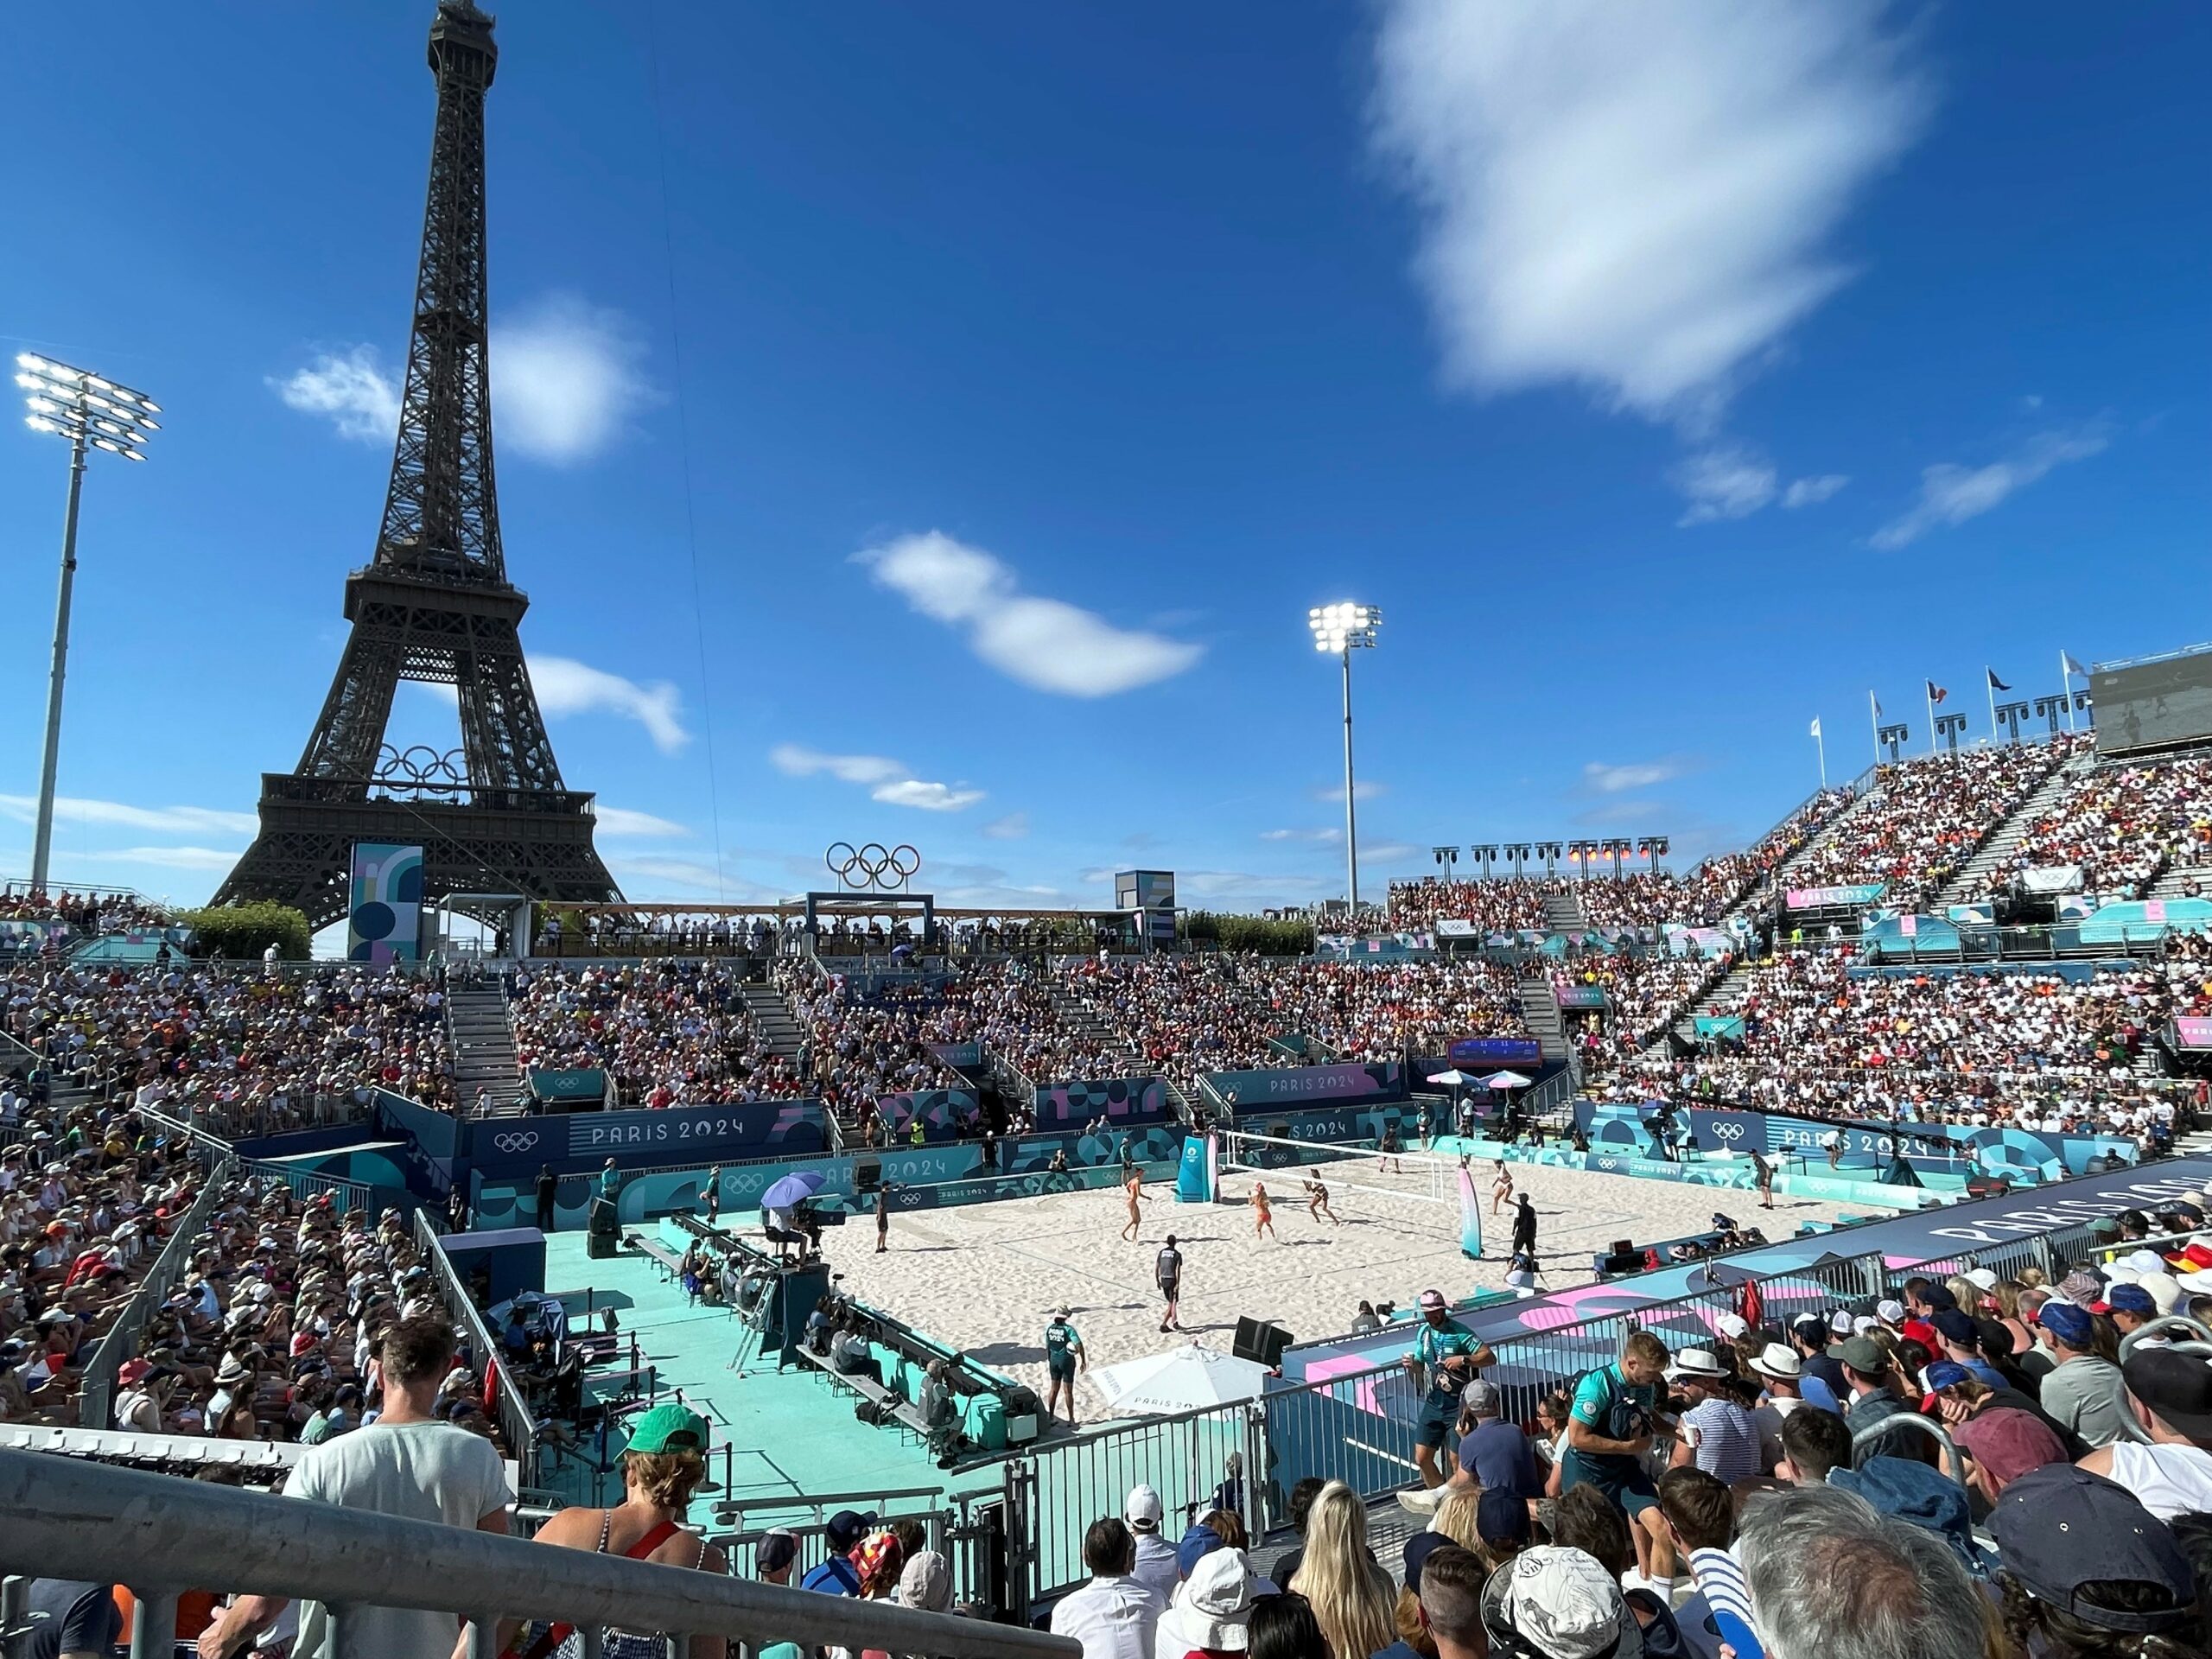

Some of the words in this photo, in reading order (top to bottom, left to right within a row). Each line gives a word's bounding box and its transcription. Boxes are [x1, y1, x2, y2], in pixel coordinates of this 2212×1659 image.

[1838, 890, 1872, 899] 2024
[1270, 1077, 1313, 1092] PARIS
[1318, 1075, 1354, 1089] 2024
[592, 1124, 668, 1145] PARIS
[679, 1118, 743, 1139] 2024
[1306, 1121, 1346, 1138] 2024
[1784, 1129, 1852, 1150] PARS
[1861, 1135, 1928, 1155] 2024
[888, 1159, 945, 1179] 2024
[1134, 1396, 1172, 1408] PARIS
